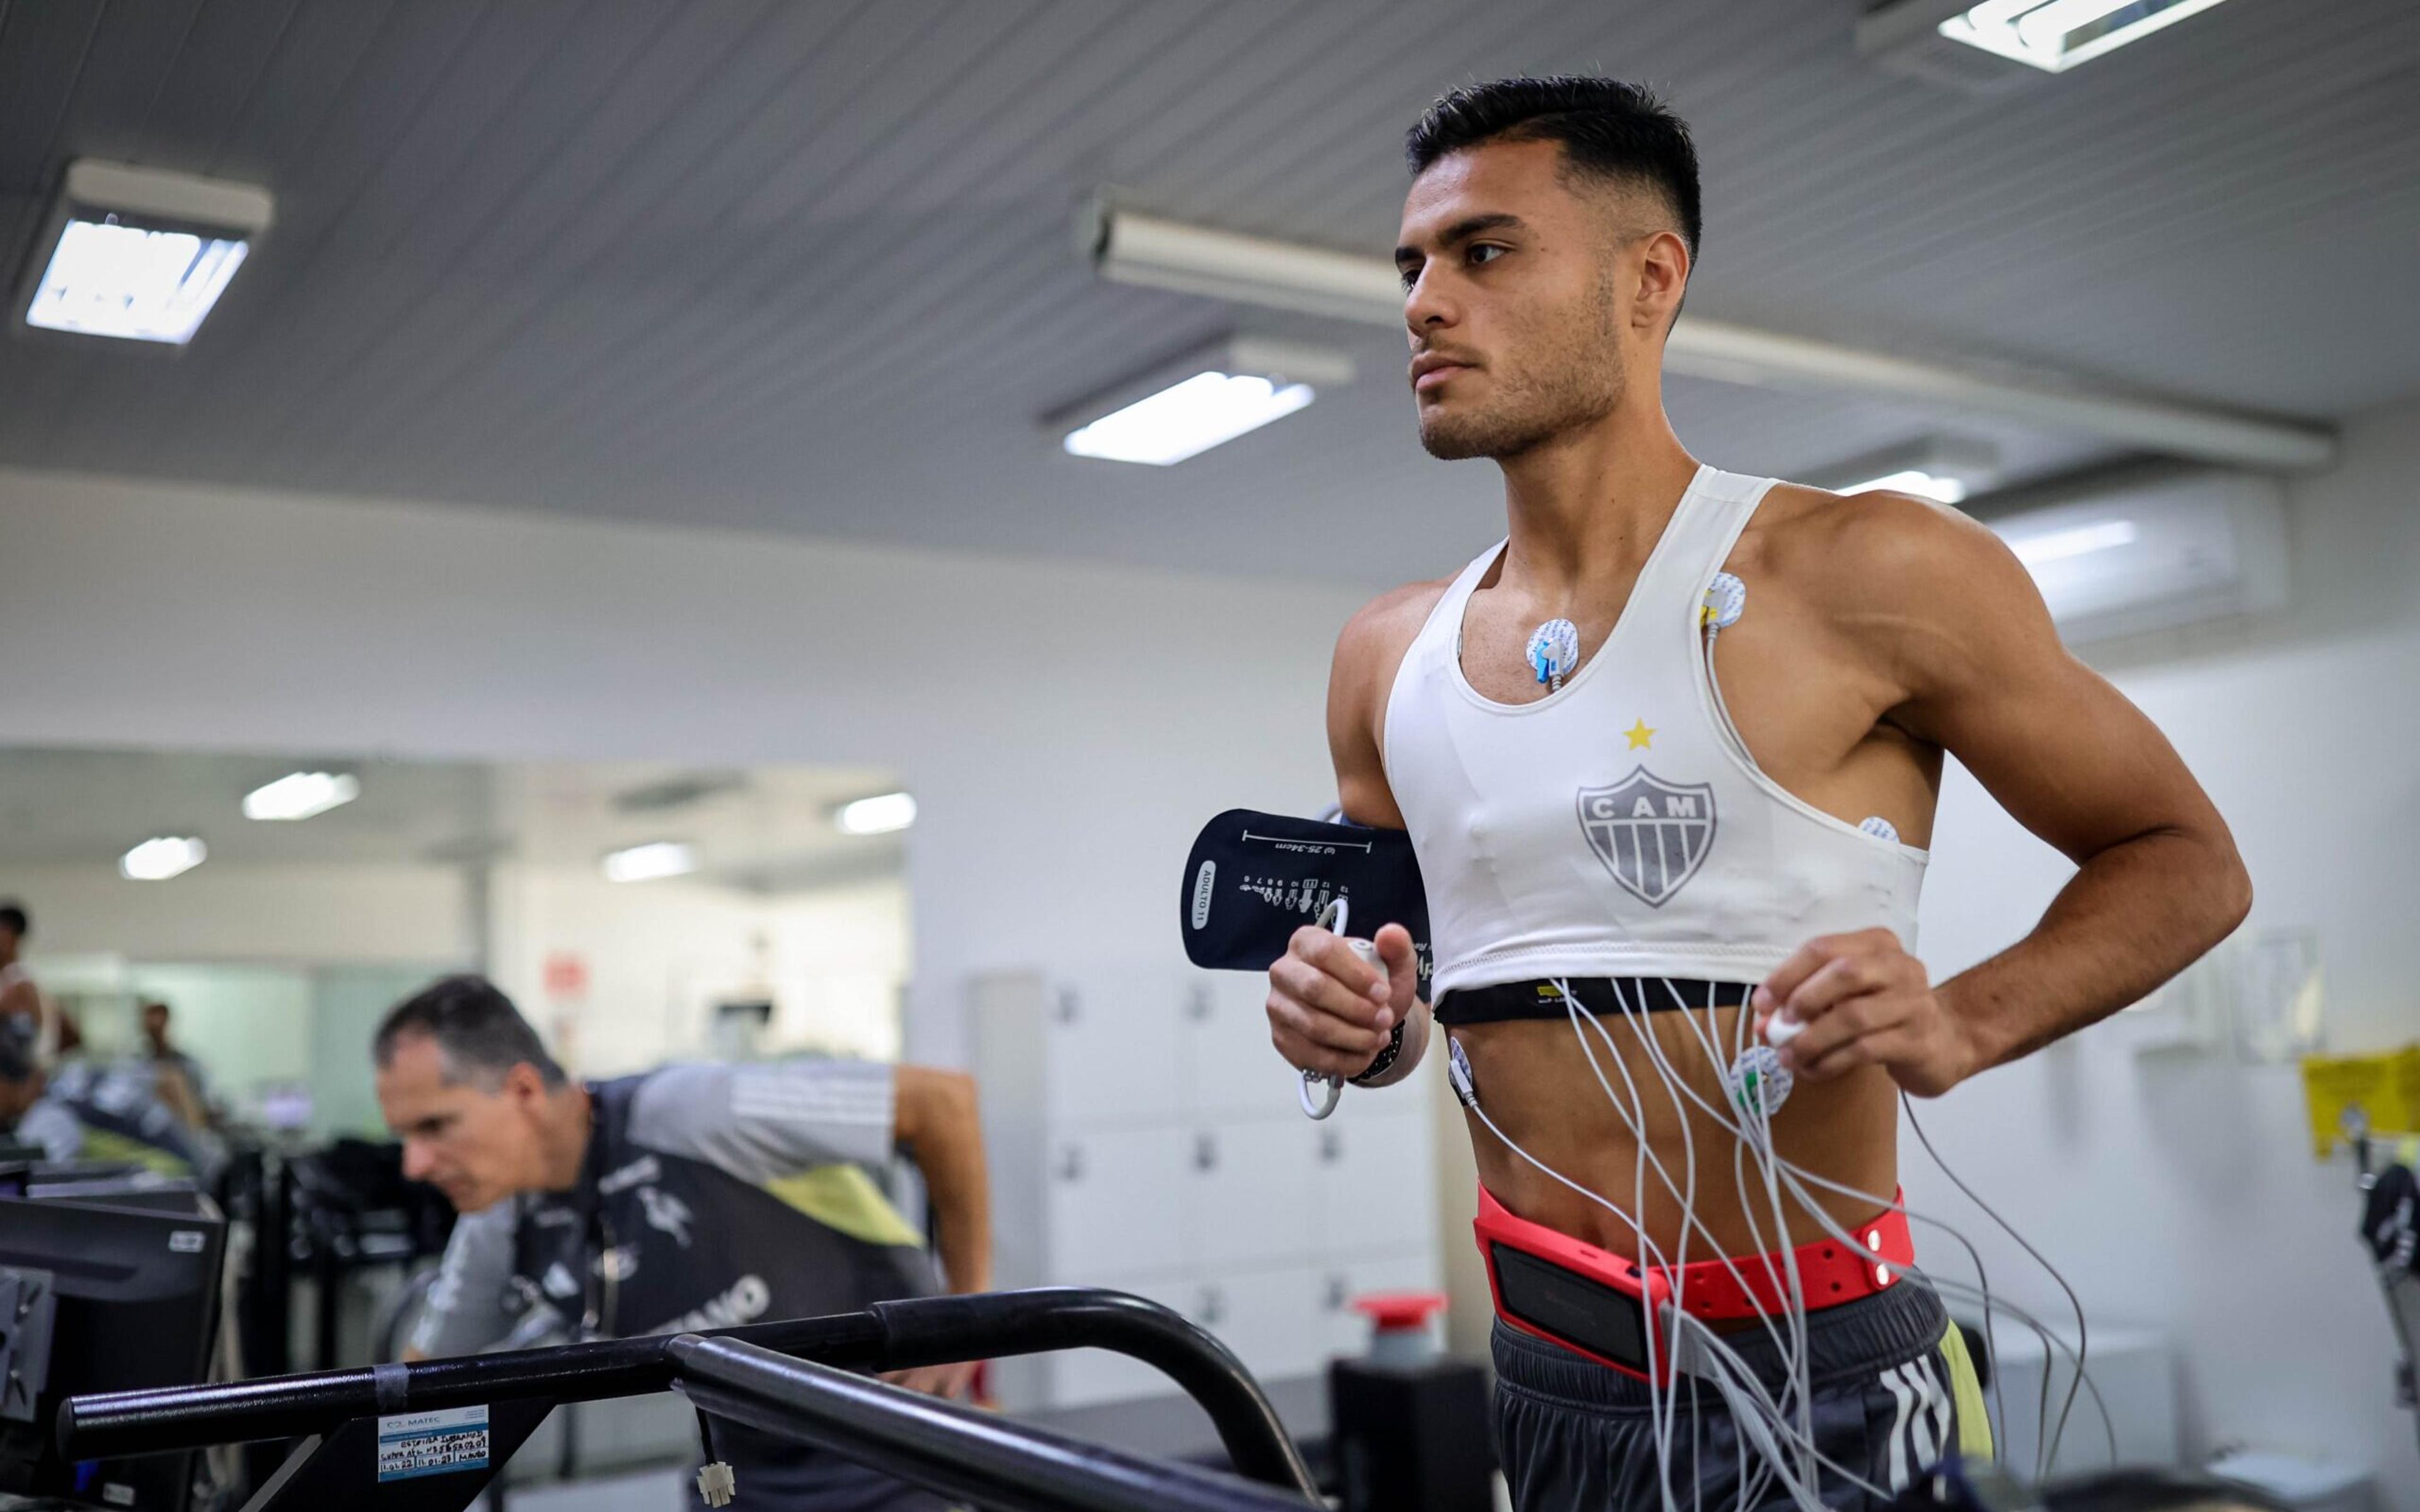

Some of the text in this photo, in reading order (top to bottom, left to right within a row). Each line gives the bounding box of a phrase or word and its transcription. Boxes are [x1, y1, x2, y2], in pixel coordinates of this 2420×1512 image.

[1275, 843, 1323, 854] 25-34cm
[1197, 870, 1211, 920] ADULTO 11
[408, 1417, 439, 1426] MATEC
